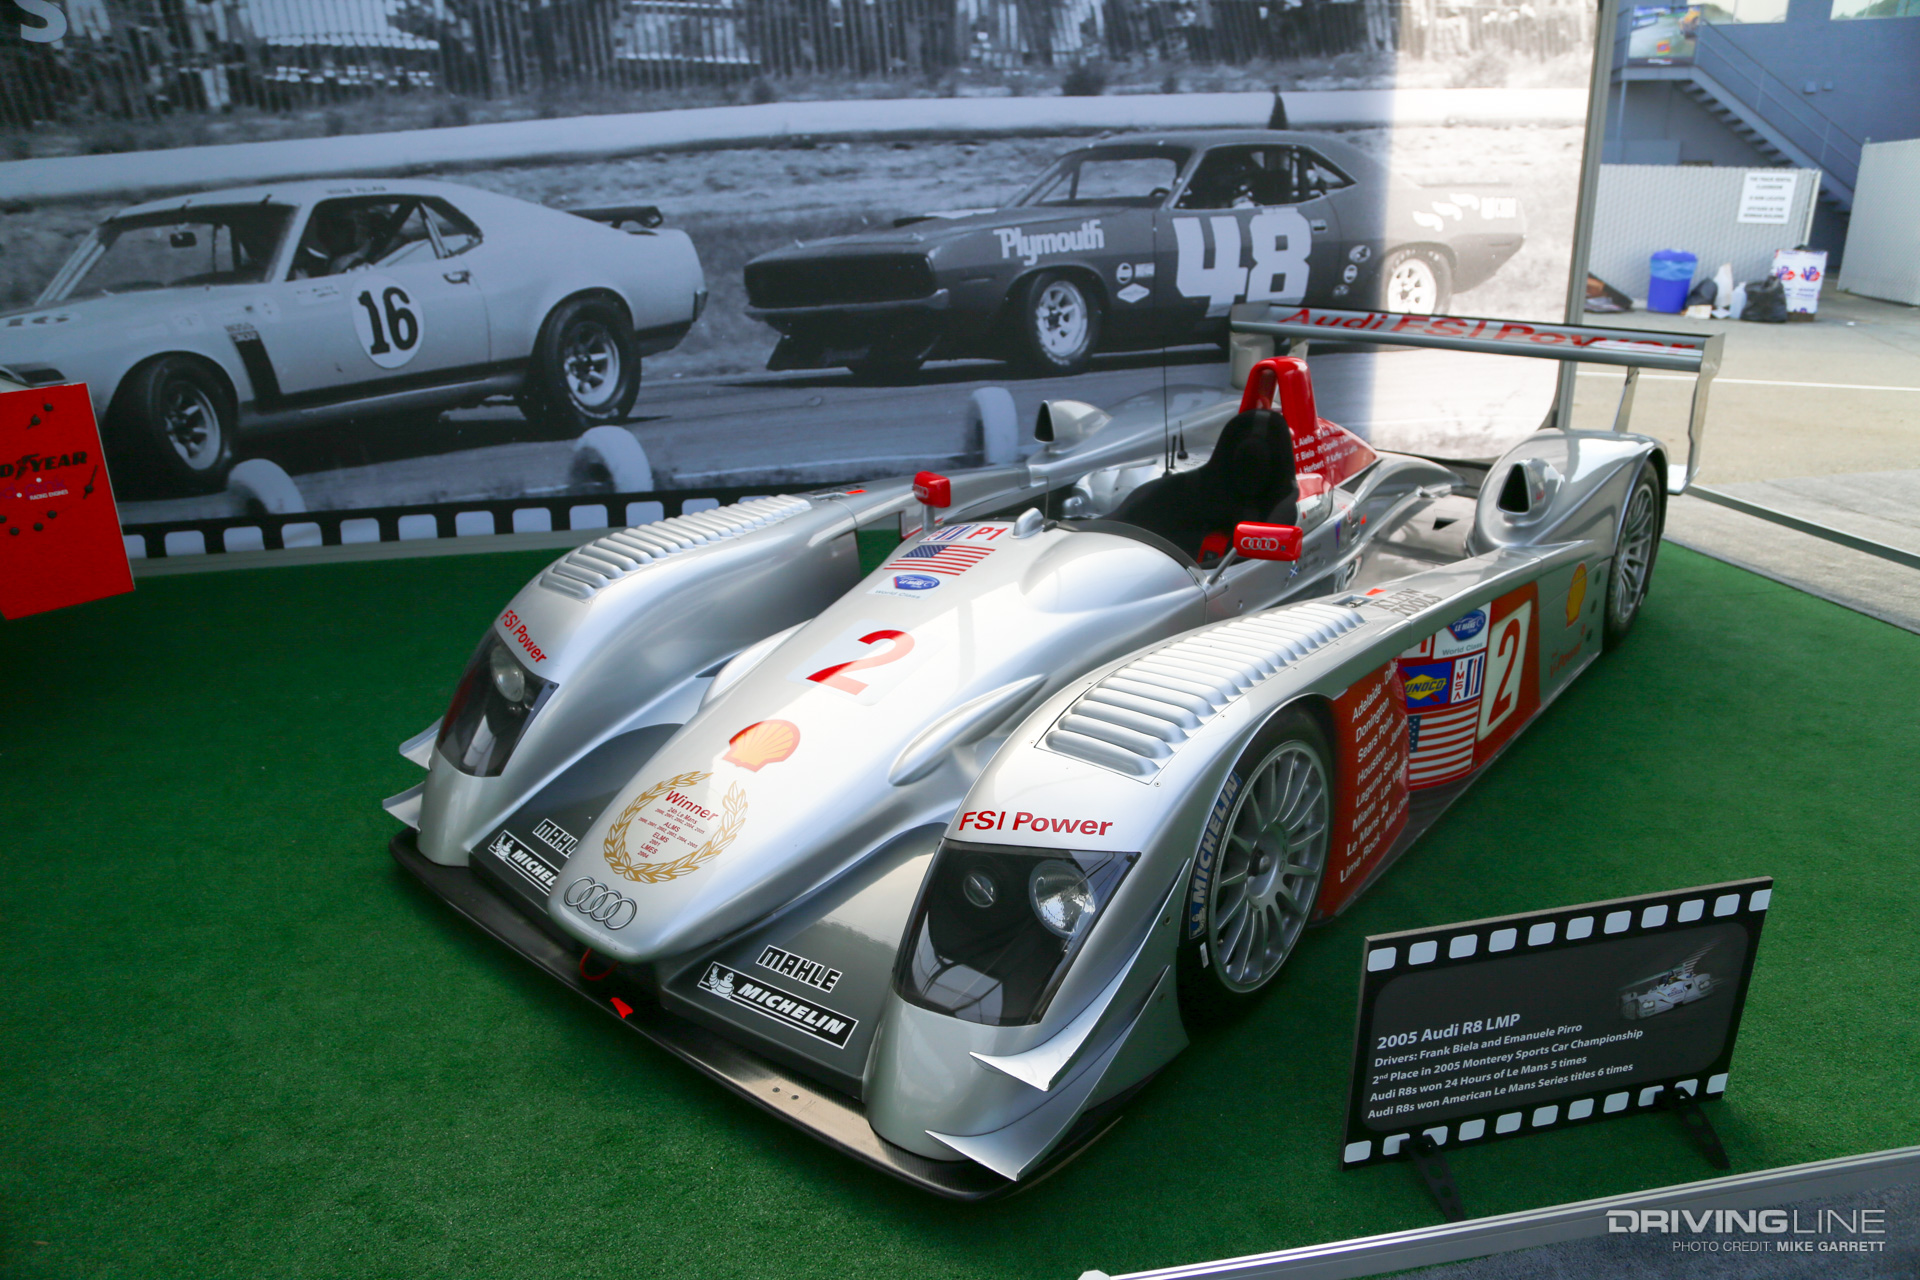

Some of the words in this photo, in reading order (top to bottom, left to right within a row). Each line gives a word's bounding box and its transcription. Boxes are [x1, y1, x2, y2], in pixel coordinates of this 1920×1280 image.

[993, 219, 1104, 266] Plymouth
[1172, 207, 1312, 318] 48
[358, 286, 419, 355] 16
[1278, 308, 1388, 329] Audi
[1390, 314, 1487, 338] FSI
[966, 526, 1008, 540] P1
[1391, 594, 1442, 616] TOOLS
[500, 609, 521, 631] FSI
[513, 624, 547, 662] Power
[1442, 646, 1464, 656] World
[1466, 642, 1483, 651] Class
[805, 630, 915, 695] 2
[1454, 661, 1465, 700] IMSA
[1488, 618, 1520, 727] 2
[1352, 684, 1381, 723] Adelaide
[1356, 697, 1389, 743] Donington
[1358, 735, 1378, 763] Sears
[1379, 713, 1393, 740] Point
[1356, 772, 1382, 808] Laguna
[1384, 752, 1398, 776] Seca
[1357, 746, 1386, 786] Houston
[664, 822, 680, 832] ALMS
[665, 790, 719, 821] Winner
[958, 810, 1006, 831] FSI
[1012, 812, 1113, 836] Power
[641, 843, 658, 854] LMES
[652, 832, 669, 843] ELMS
[1192, 772, 1238, 904] MICHELIN
[1347, 841, 1358, 856] Le
[1359, 816, 1380, 844] Mans
[1341, 857, 1361, 883] Lime
[756, 944, 843, 993] MAHLE
[737, 983, 846, 1035] MICHELIN
[1375, 1053, 1418, 1067] Drivers:
[1420, 1046, 1450, 1060] Frank
[1453, 1041, 1479, 1054] Biela
[1481, 1037, 1501, 1049] and
[1504, 1028, 1555, 1044] Emanuele
[1557, 1024, 1582, 1036] Pirro
[1377, 1031, 1418, 1049] 2005
[1421, 1024, 1459, 1041] Audi
[1462, 1020, 1482, 1035] R8
[1486, 1013, 1520, 1031] LMP
[1372, 1073, 1388, 1084] 2nd
[1390, 1069, 1419, 1081] Place
[1421, 1067, 1431, 1076] in
[1434, 1061, 1460, 1074] 2005
[1463, 1052, 1514, 1069] Monterey
[1516, 1046, 1549, 1060] Sports
[1551, 1043, 1569, 1053] Car
[1571, 1029, 1643, 1049] Championship
[1368, 1106, 1394, 1119] Audi
[1396, 1104, 1414, 1114] R8s
[1417, 1100, 1440, 1110] won
[1442, 1089, 1491, 1105] American
[1494, 1086, 1506, 1096] Le
[1508, 1081, 1536, 1093] Mans
[1538, 1076, 1568, 1088] Series
[1570, 1071, 1596, 1081] titles
[1597, 1068, 1604, 1076] 6
[1606, 1064, 1633, 1075] times
[1370, 1088, 1396, 1102] Audi
[1398, 1086, 1417, 1097] R8s
[1420, 1083, 1442, 1093] won
[1444, 1078, 1458, 1088] 24
[1460, 1072, 1491, 1085] Hours
[1494, 1069, 1506, 1079] of
[1507, 1068, 1519, 1077] Le
[1520, 1064, 1548, 1075] Mans
[1550, 1060, 1557, 1070] 5
[1559, 1056, 1587, 1068] times
